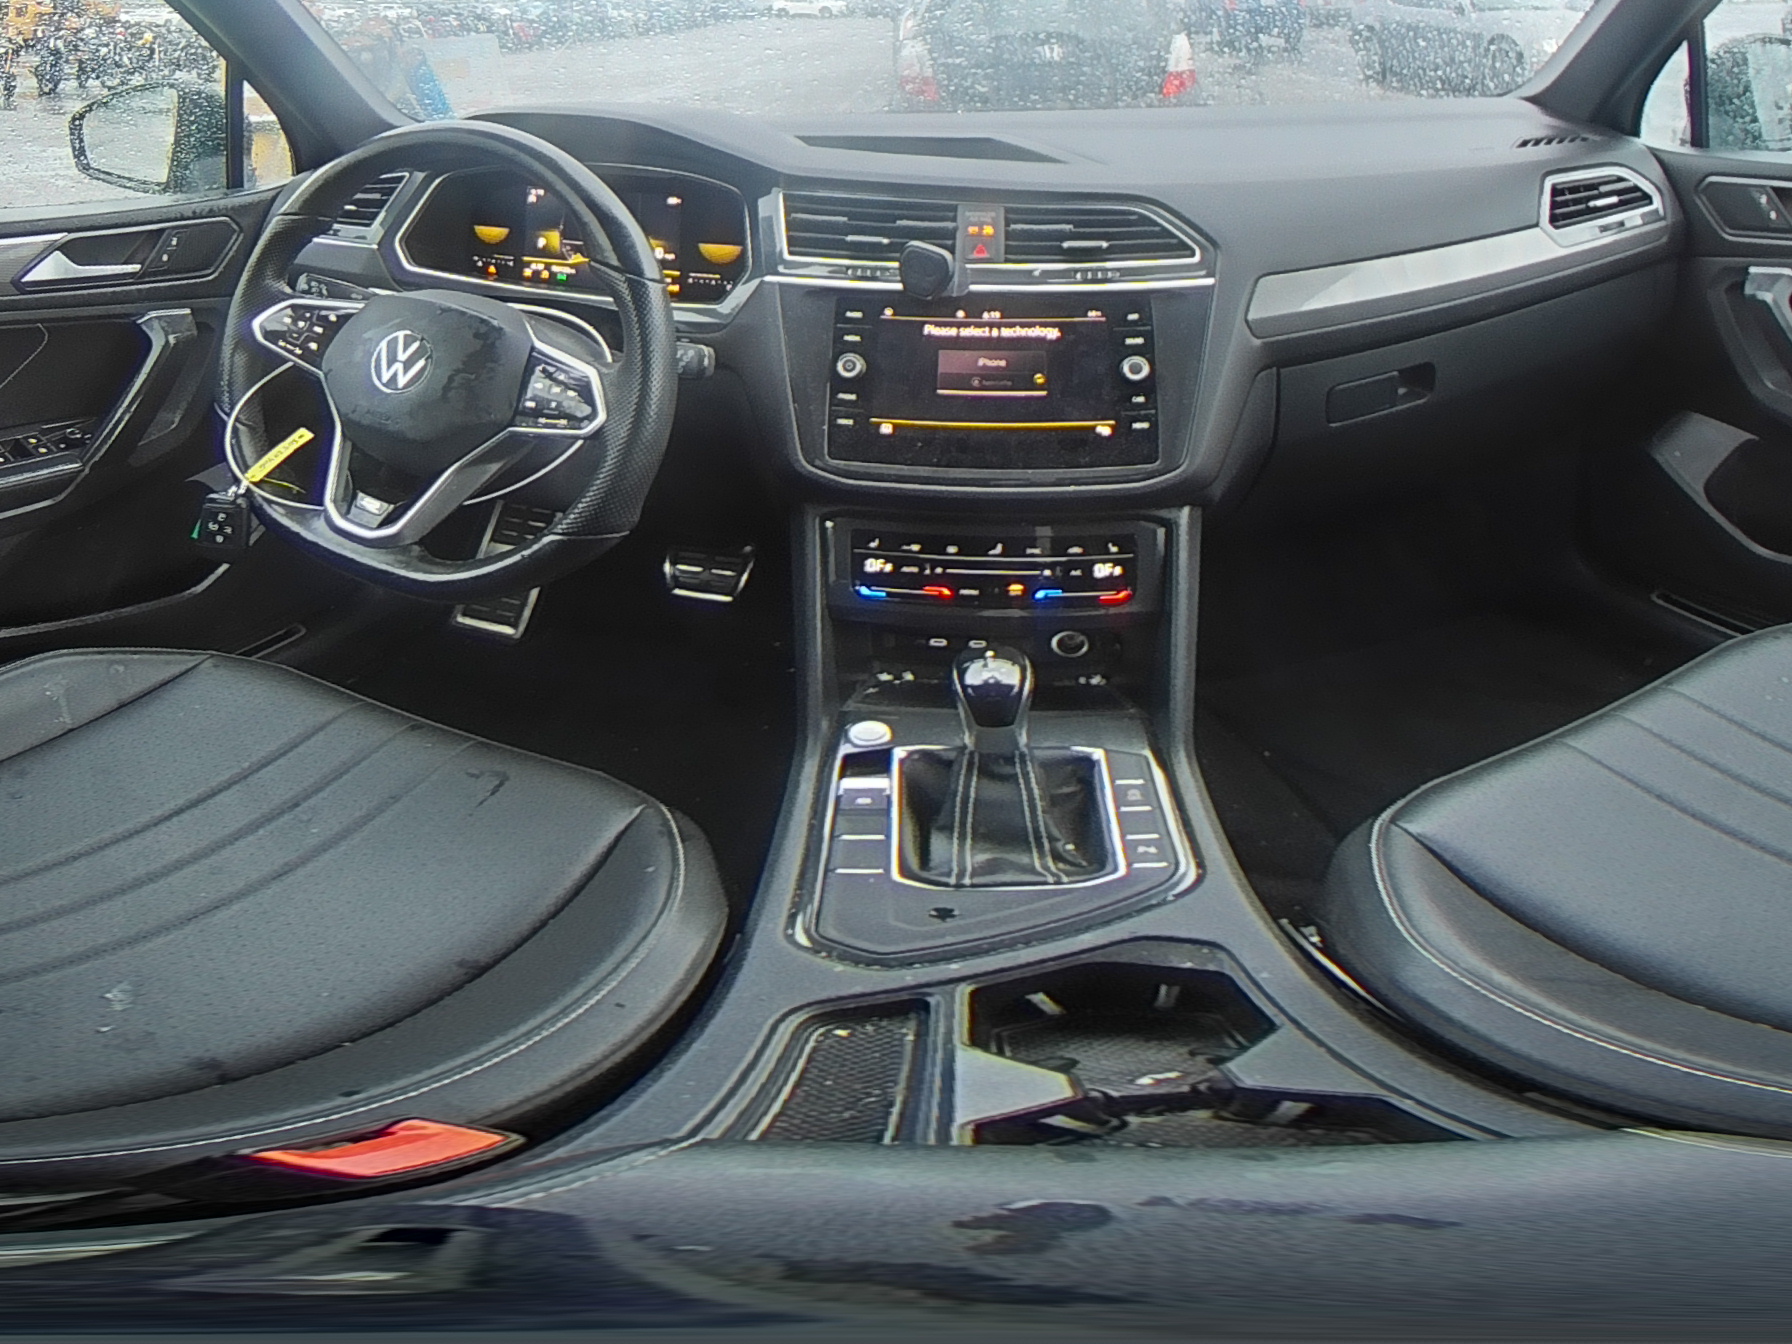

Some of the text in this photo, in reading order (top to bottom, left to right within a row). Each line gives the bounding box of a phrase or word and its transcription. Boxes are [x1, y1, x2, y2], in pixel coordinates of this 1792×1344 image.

[923, 324, 1062, 340] Please select a technology.
[977, 356, 1007, 368] iPhone
